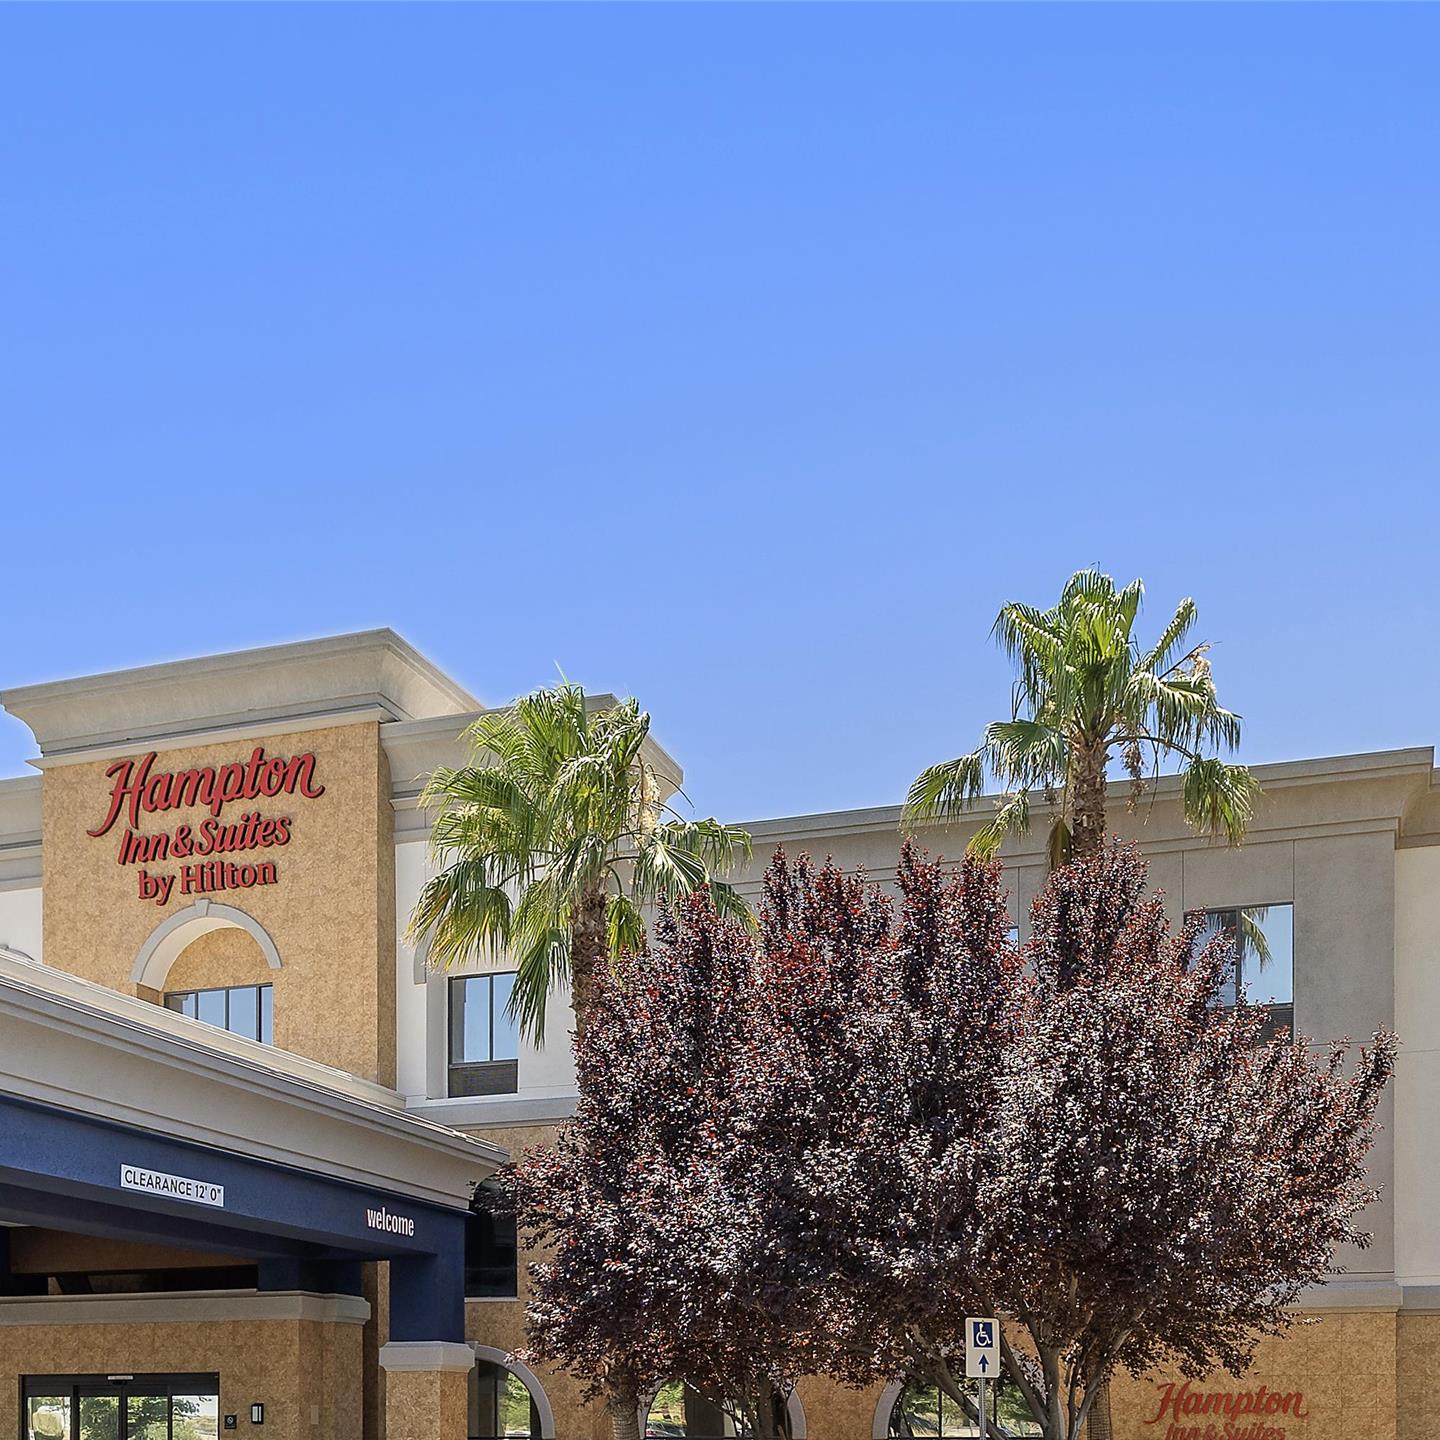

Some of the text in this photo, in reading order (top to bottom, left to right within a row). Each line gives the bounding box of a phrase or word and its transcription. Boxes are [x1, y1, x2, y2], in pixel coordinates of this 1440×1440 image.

[86, 746, 326, 837] Hampton
[138, 859, 278, 906] by Hilton
[124, 1169, 193, 1197] CLEARANCE
[367, 1207, 415, 1237] welcome
[1143, 1381, 1309, 1424] Hampton
